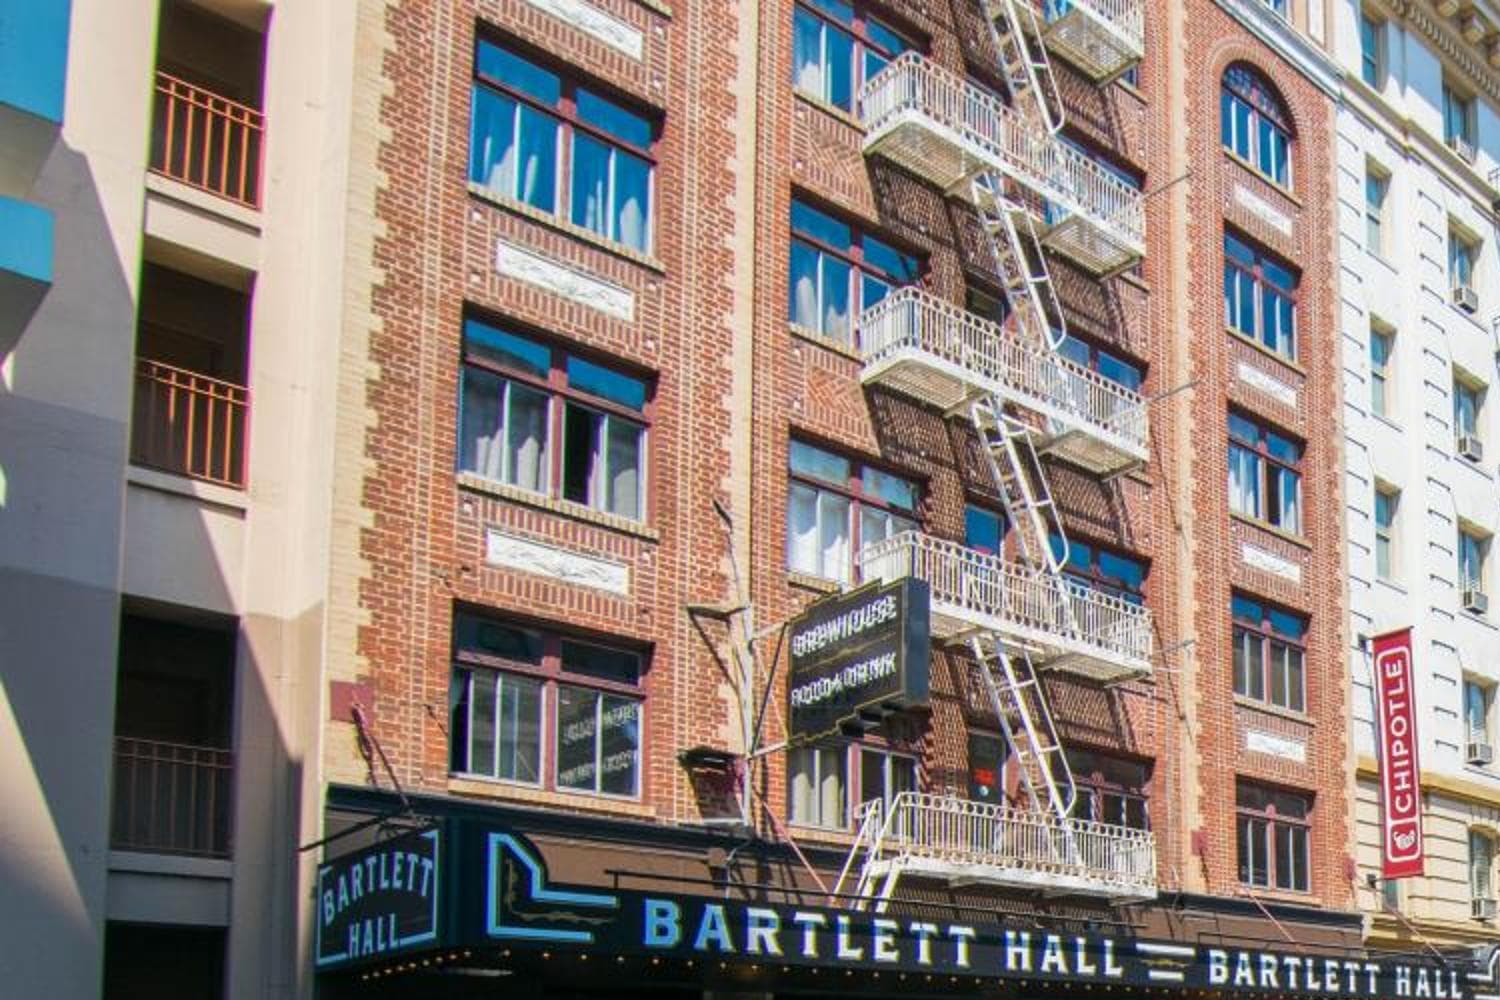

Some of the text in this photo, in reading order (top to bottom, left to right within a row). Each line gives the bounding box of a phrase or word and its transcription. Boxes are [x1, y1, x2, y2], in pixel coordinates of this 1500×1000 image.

[1385, 659, 1412, 813] CHIPOTLE
[323, 851, 433, 926] BARTLETT
[349, 913, 399, 958] HALL
[643, 898, 1125, 978] BARTLETT HALL
[1208, 949, 1464, 1000] BARTLETT HALL
